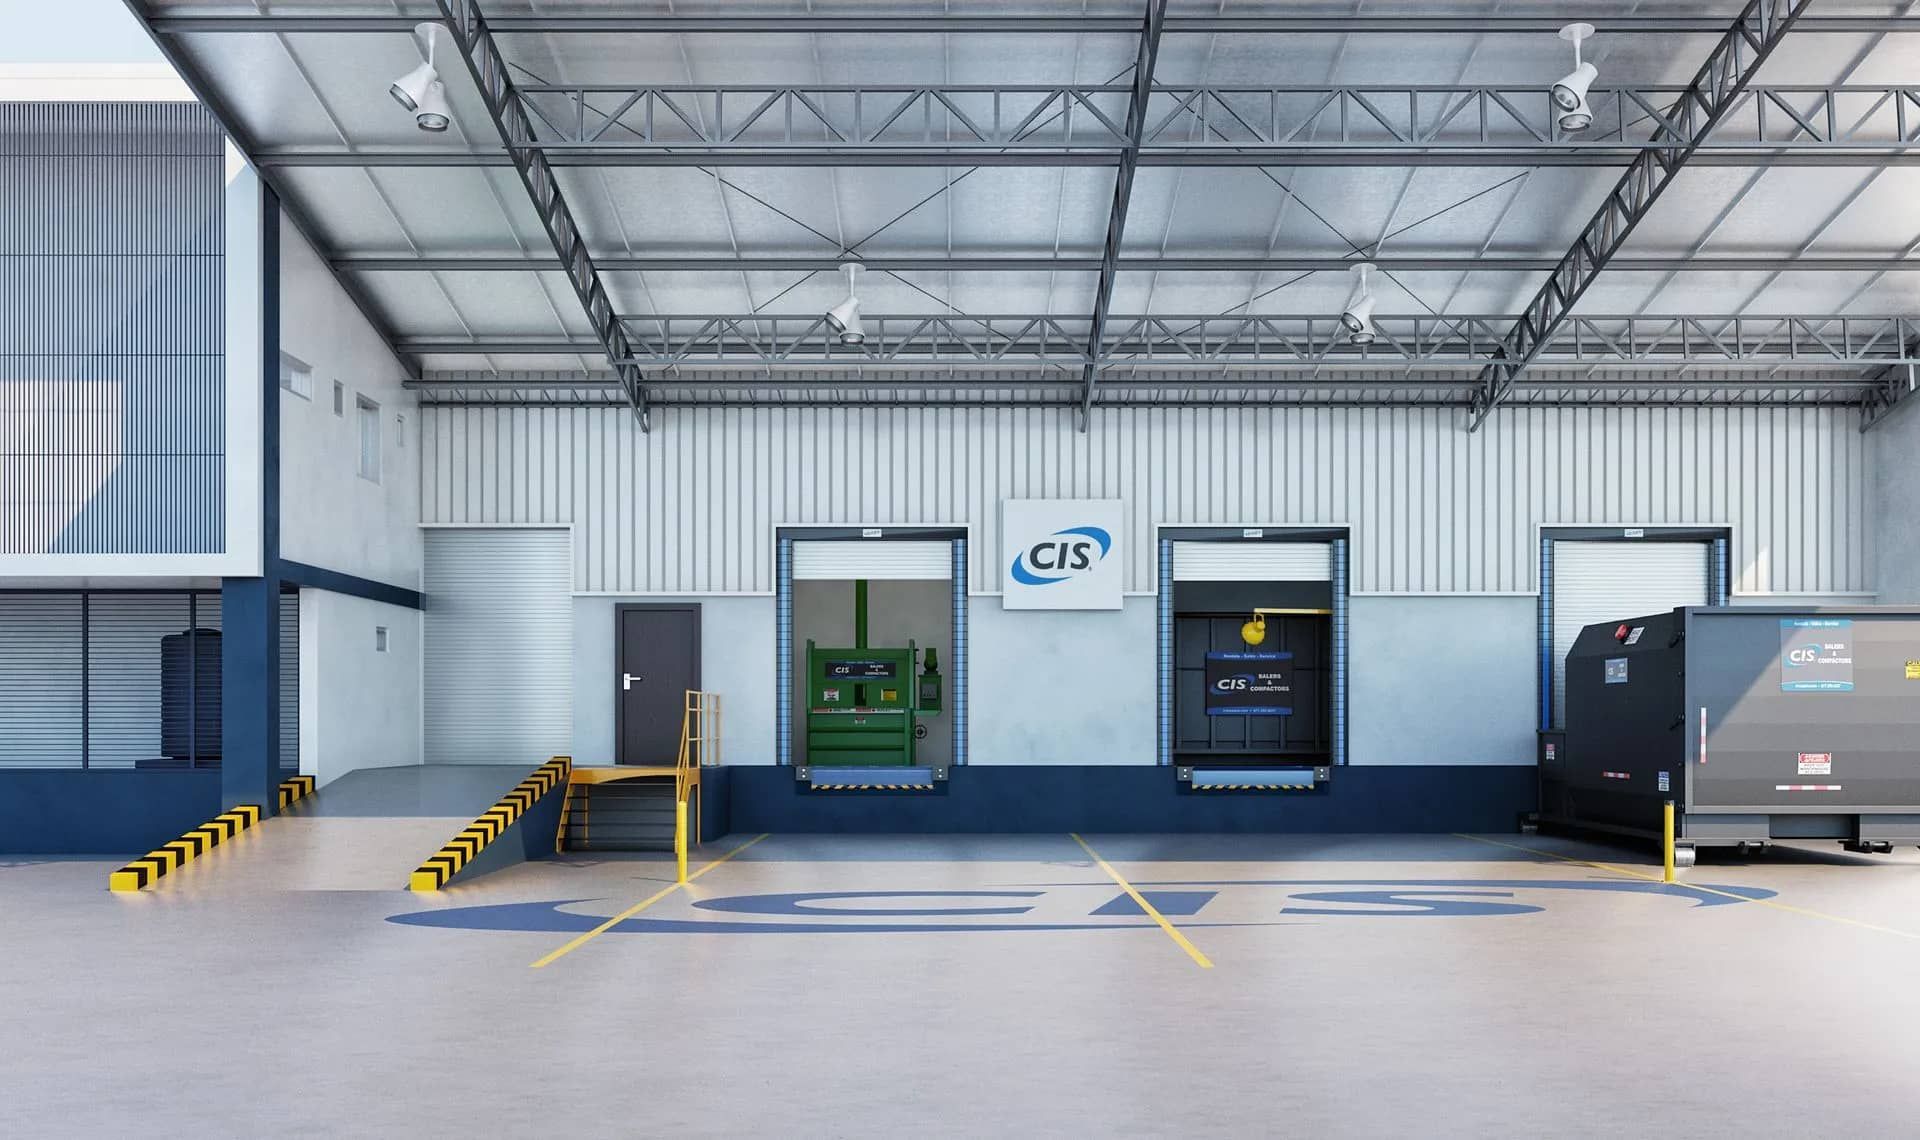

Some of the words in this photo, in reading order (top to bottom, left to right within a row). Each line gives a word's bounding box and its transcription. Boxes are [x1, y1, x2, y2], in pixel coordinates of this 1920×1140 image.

[1029, 542, 1091, 571] CIS
[1790, 649, 1816, 662] CIS
[835, 666, 850, 674] CIS
[1217, 679, 1247, 690] CIS
